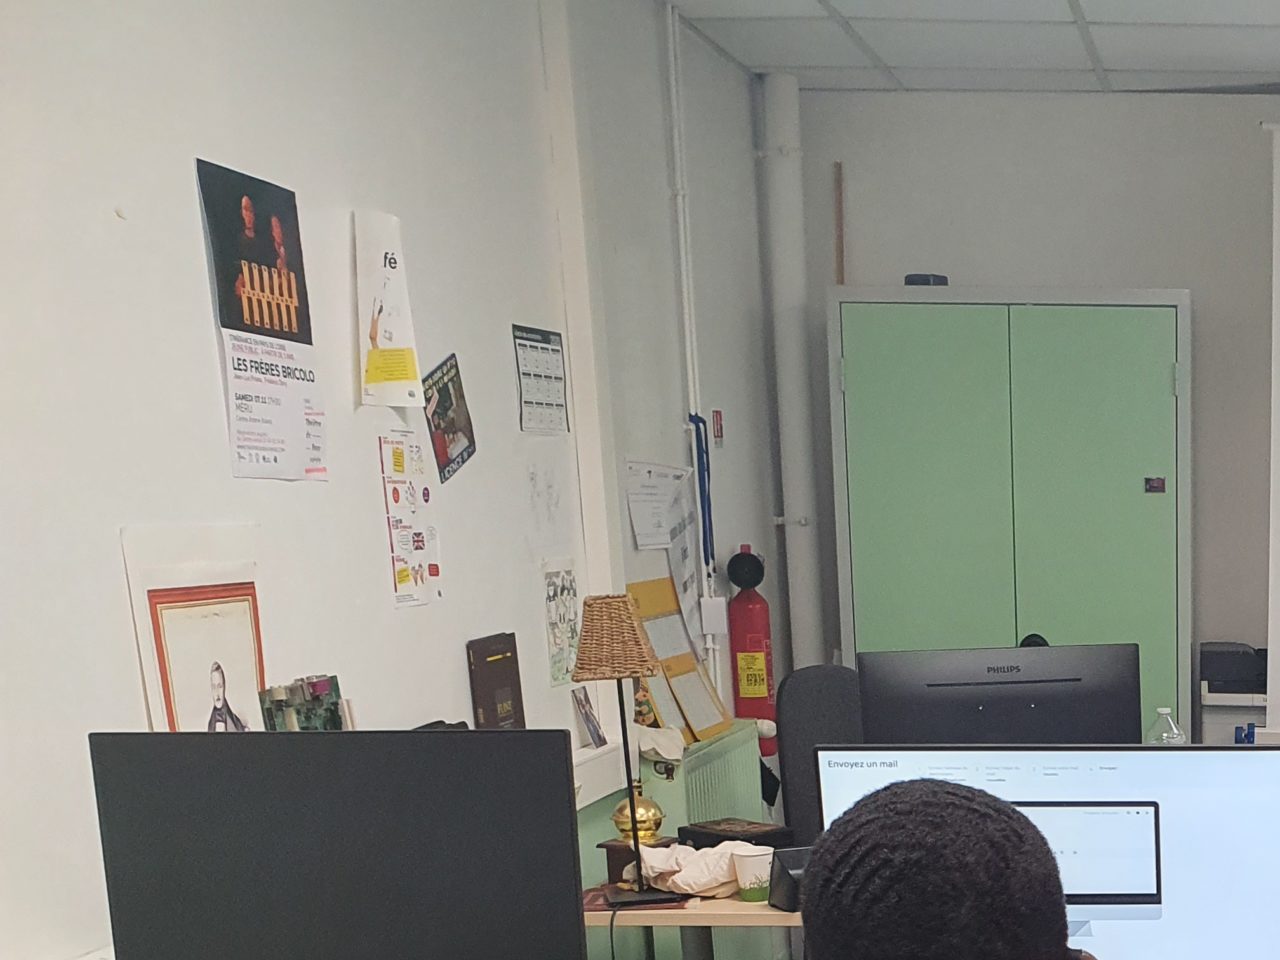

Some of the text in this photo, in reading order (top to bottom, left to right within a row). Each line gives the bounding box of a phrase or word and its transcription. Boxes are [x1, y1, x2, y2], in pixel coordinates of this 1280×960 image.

[383, 252, 398, 269] fé
[232, 357, 315, 383] LES FRÈRES BRICOLO
[987, 665, 1021, 674] PHILIPS
[828, 760, 864, 769] Envoyez
[879, 760, 898, 768] mail
